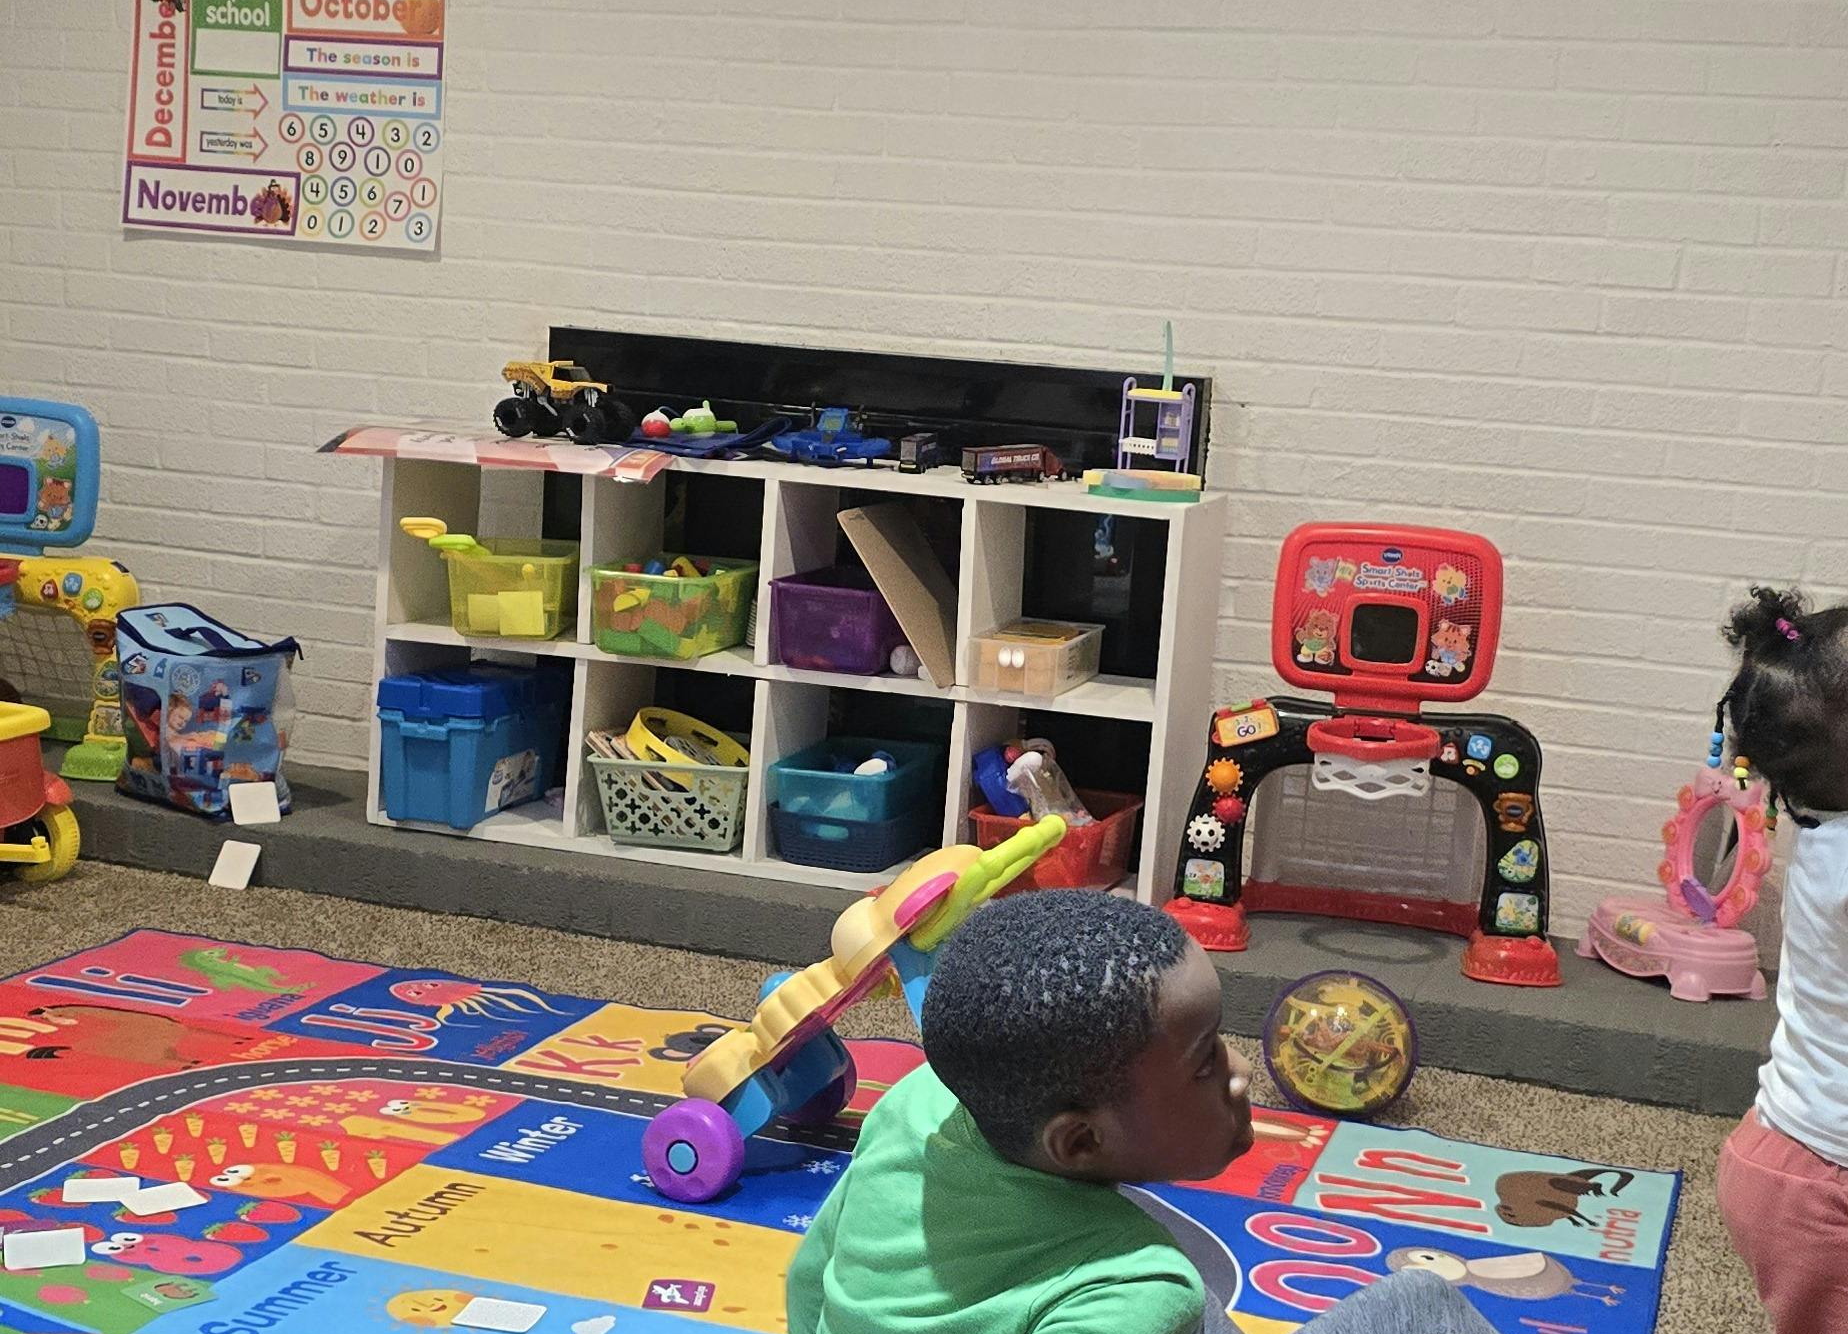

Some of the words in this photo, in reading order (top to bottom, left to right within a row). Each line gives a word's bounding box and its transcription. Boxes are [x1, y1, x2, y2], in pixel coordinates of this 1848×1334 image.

[206, 0, 270, 27] school
[306, 46, 337, 64] The
[343, 50, 402, 68] season
[406, 51, 420, 68] is
[298, 85, 330, 102] The
[335, 88, 406, 107] weather
[412, 90, 426, 108] is
[286, 121, 297, 137] 6
[318, 123, 329, 139] 5
[355, 123, 366, 140] 4
[390, 126, 401, 143] 3
[422, 131, 432, 147] 2
[304, 150, 315, 166] 8
[337, 150, 348, 165] 9
[404, 157, 415, 173] 0
[309, 182, 320, 197] 4
[338, 184, 349, 200] 5
[366, 184, 377, 200] 6
[392, 199, 403, 215] 7
[307, 215, 317, 230] 0
[368, 219, 379, 235] 2
[413, 220, 424, 236] 3
[1362, 564, 1391, 575] Smart
[1388, 579, 1419, 590] Center
[513, 1034, 648, 1079] Kk
[478, 1116, 584, 1164] Winter
[353, 1179, 486, 1249] Autumn
[1601, 1207, 1640, 1265] nutria
